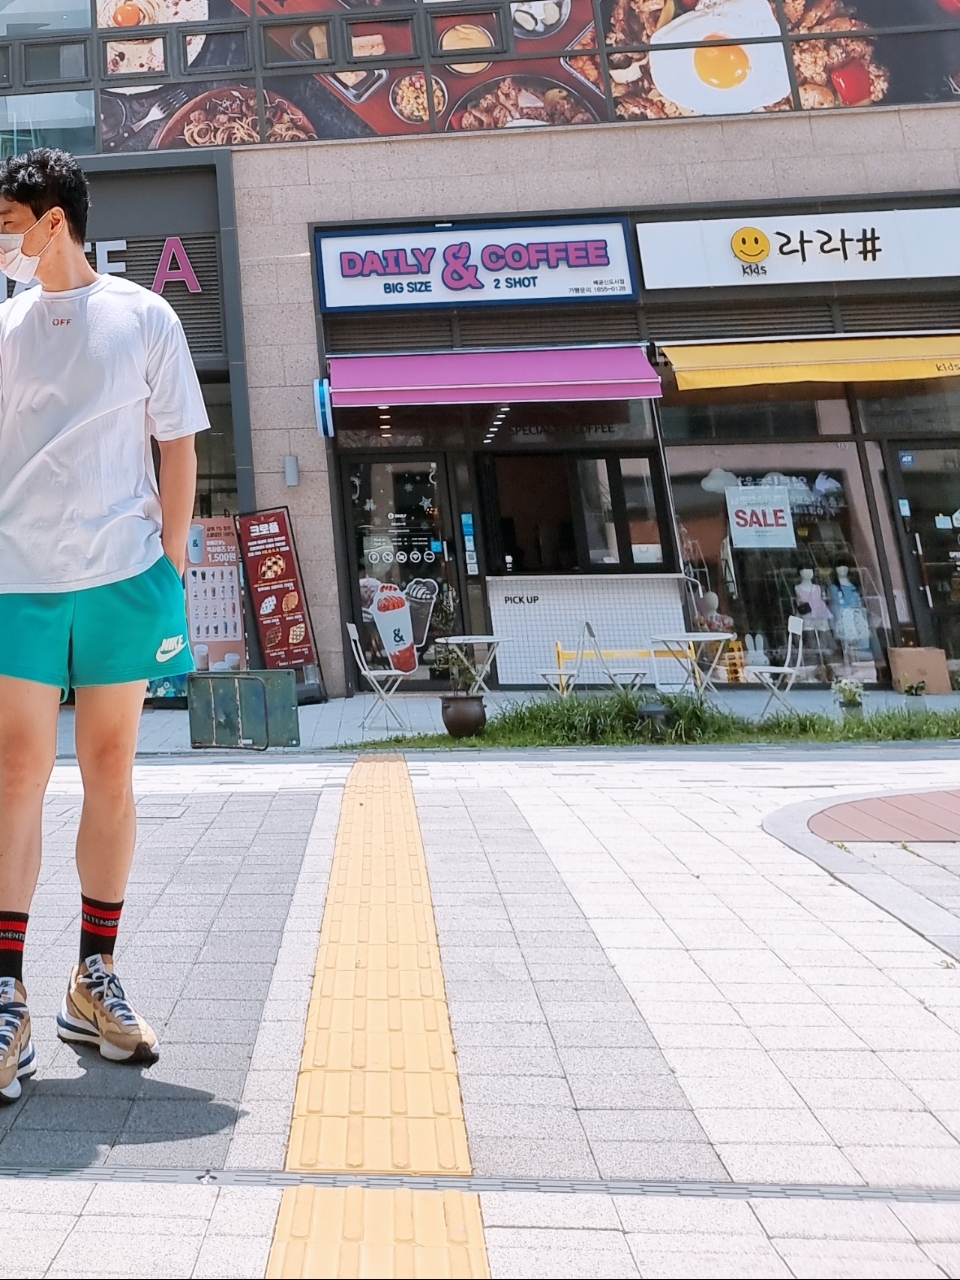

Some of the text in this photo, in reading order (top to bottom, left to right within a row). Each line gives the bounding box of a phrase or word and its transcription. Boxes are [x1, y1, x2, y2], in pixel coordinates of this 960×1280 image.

[150, 236, 202, 294] A
[340, 239, 610, 291] DAILY & COFFEE
[741, 264, 767, 276] kids
[383, 276, 538, 294] BIG SIZE 2 SHOT
[52, 318, 72, 326] OFF
[734, 509, 788, 528] SALE
[504, 595, 539, 604] PICK UP
[160, 634, 184, 651] NIKE
